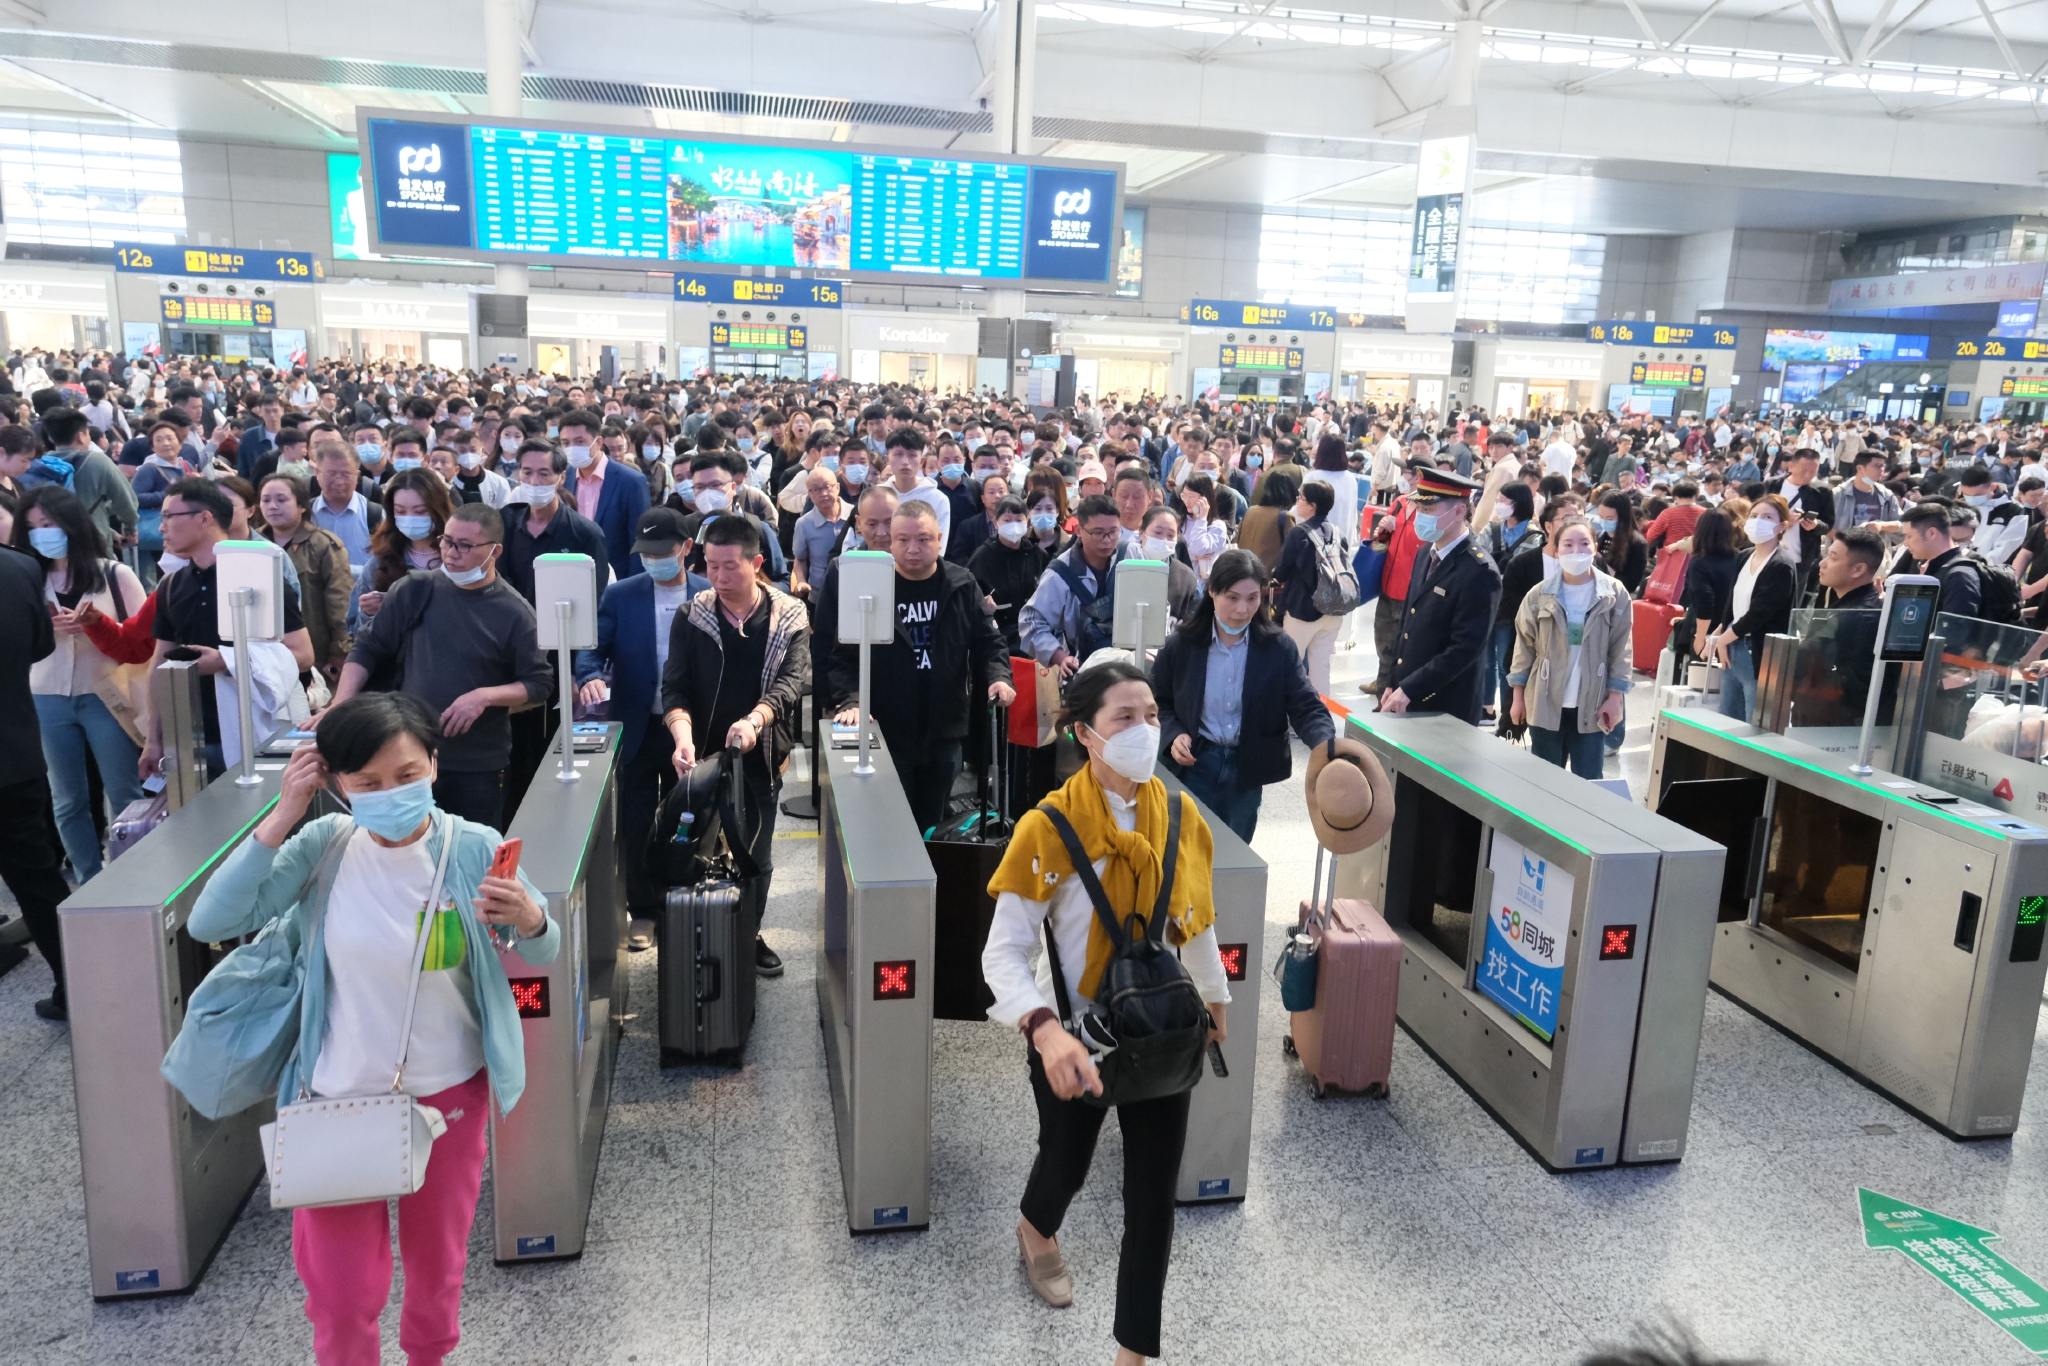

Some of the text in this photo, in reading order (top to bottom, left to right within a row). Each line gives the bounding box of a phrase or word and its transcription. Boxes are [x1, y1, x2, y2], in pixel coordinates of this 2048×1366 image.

[1440, 206, 1460, 261] 兔宝宝
[118, 248, 153, 267] 12B
[209, 252, 244, 266] 检票口
[209, 265, 230, 273] Check
[276, 257, 308, 276] 13B
[677, 278, 706, 296] 14B
[754, 283, 784, 294] 检票口
[1944, 272, 2019, 292] 文明出行
[811, 286, 838, 303] 15B
[362, 303, 430, 322] BALLY
[1194, 305, 1219, 321] 16B
[1260, 308, 1287, 318] 检票口
[1309, 311, 1333, 326] 17B
[576, 313, 619, 330] BOSS
[879, 326, 949, 344] Koradior
[1611, 326, 1633, 340] 18B
[1670, 328, 1693, 337] 检票口
[1713, 330, 1735, 345] 19B
[1956, 342, 1978, 356] 20B
[1983, 342, 2006, 356] 20B
[1516, 886, 1545, 910] 自助通道
[1501, 906, 1555, 963] 58同城
[1487, 947, 1553, 1016] 找工作
[1891, 1210, 1923, 1219] CRH
[1955, 1236, 2004, 1270] Transfer
[1902, 1239, 2012, 1311] 持联程票
[1929, 1237, 2040, 1308] 换乘通道
